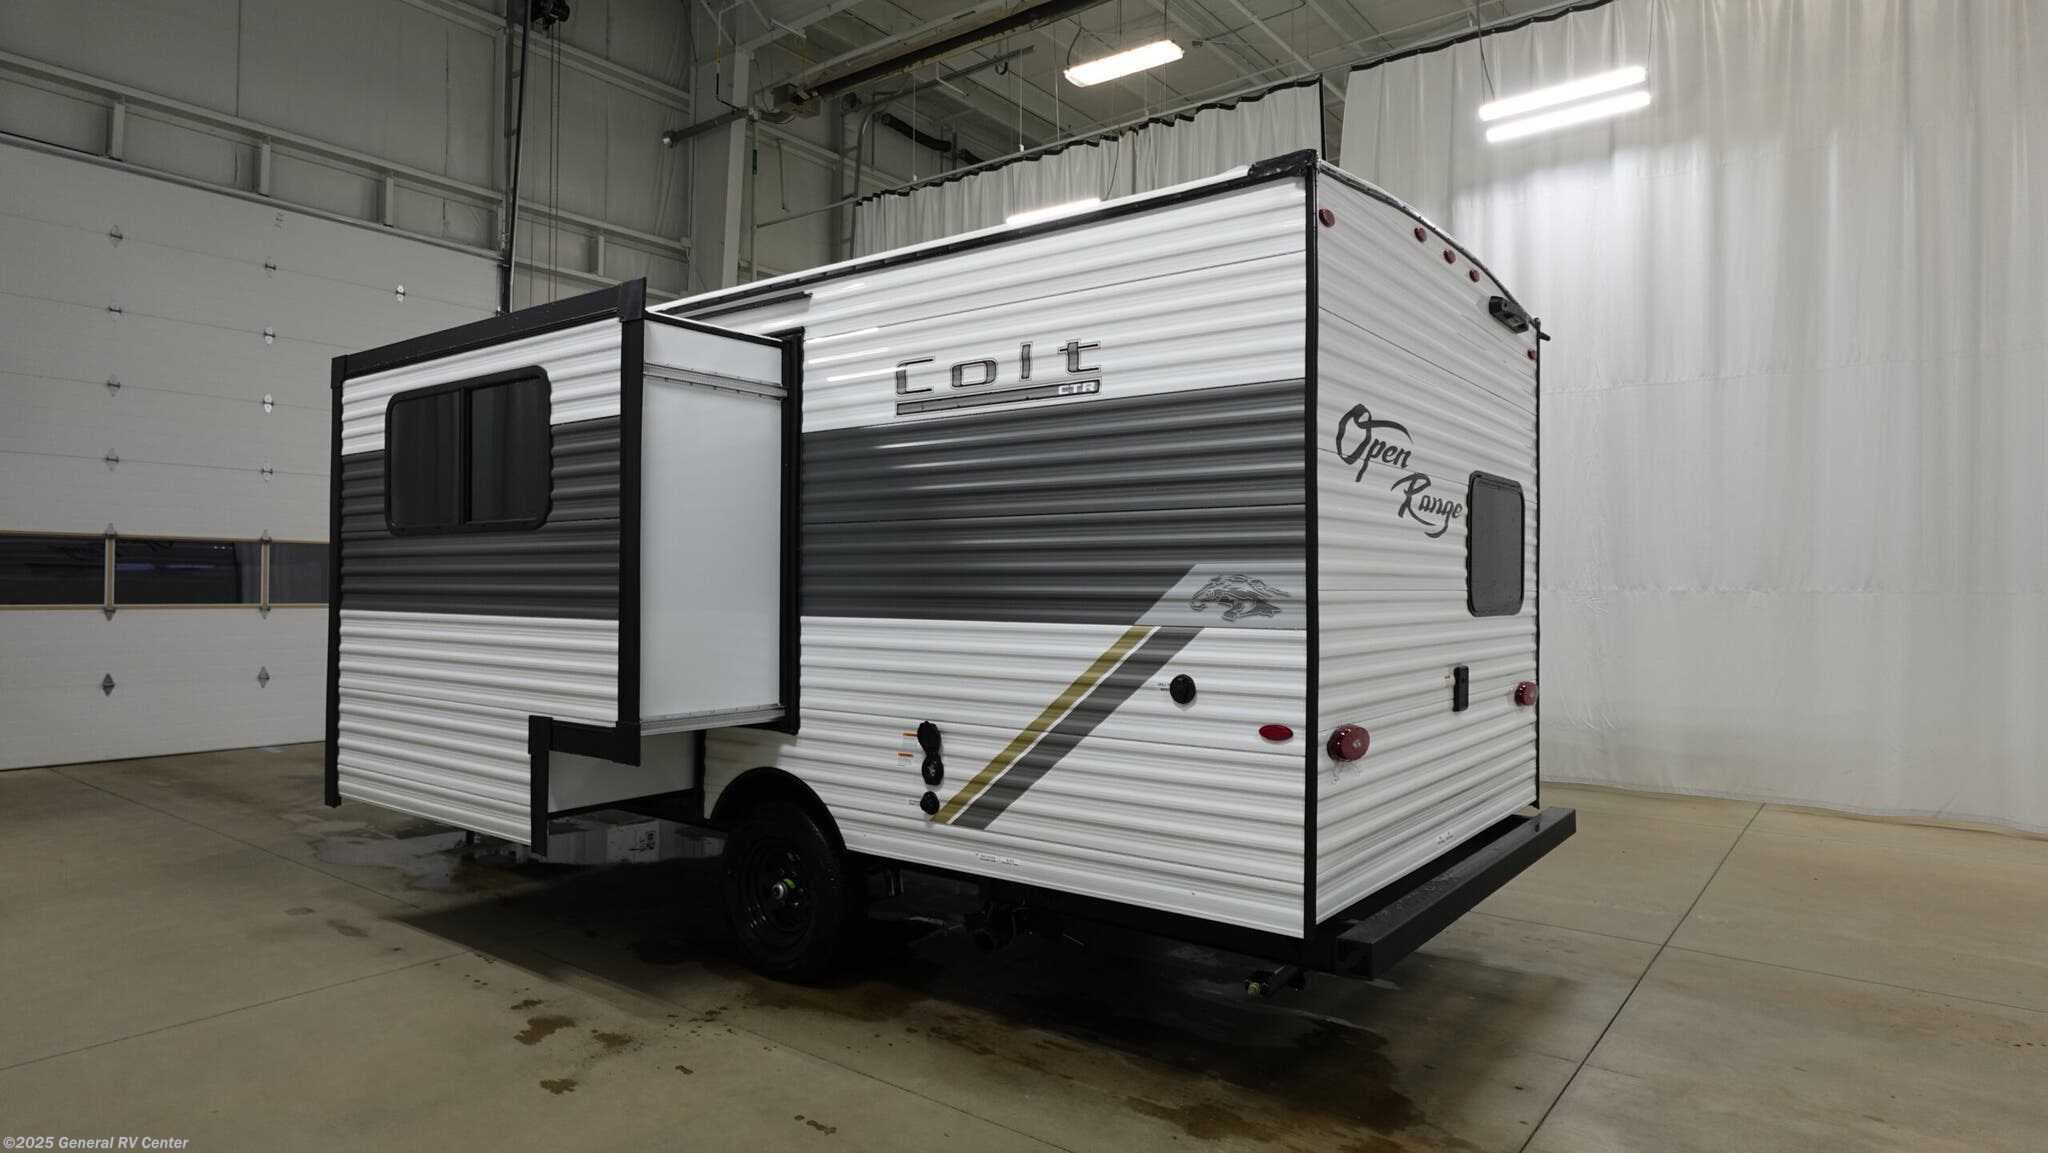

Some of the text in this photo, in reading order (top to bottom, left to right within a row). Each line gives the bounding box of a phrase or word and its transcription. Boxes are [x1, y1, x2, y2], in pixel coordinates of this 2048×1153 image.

[896, 339, 1101, 396] Colt
[1058, 382, 1096, 395] CTR
[1336, 403, 1414, 483] Open
[1390, 472, 1463, 538] Range
